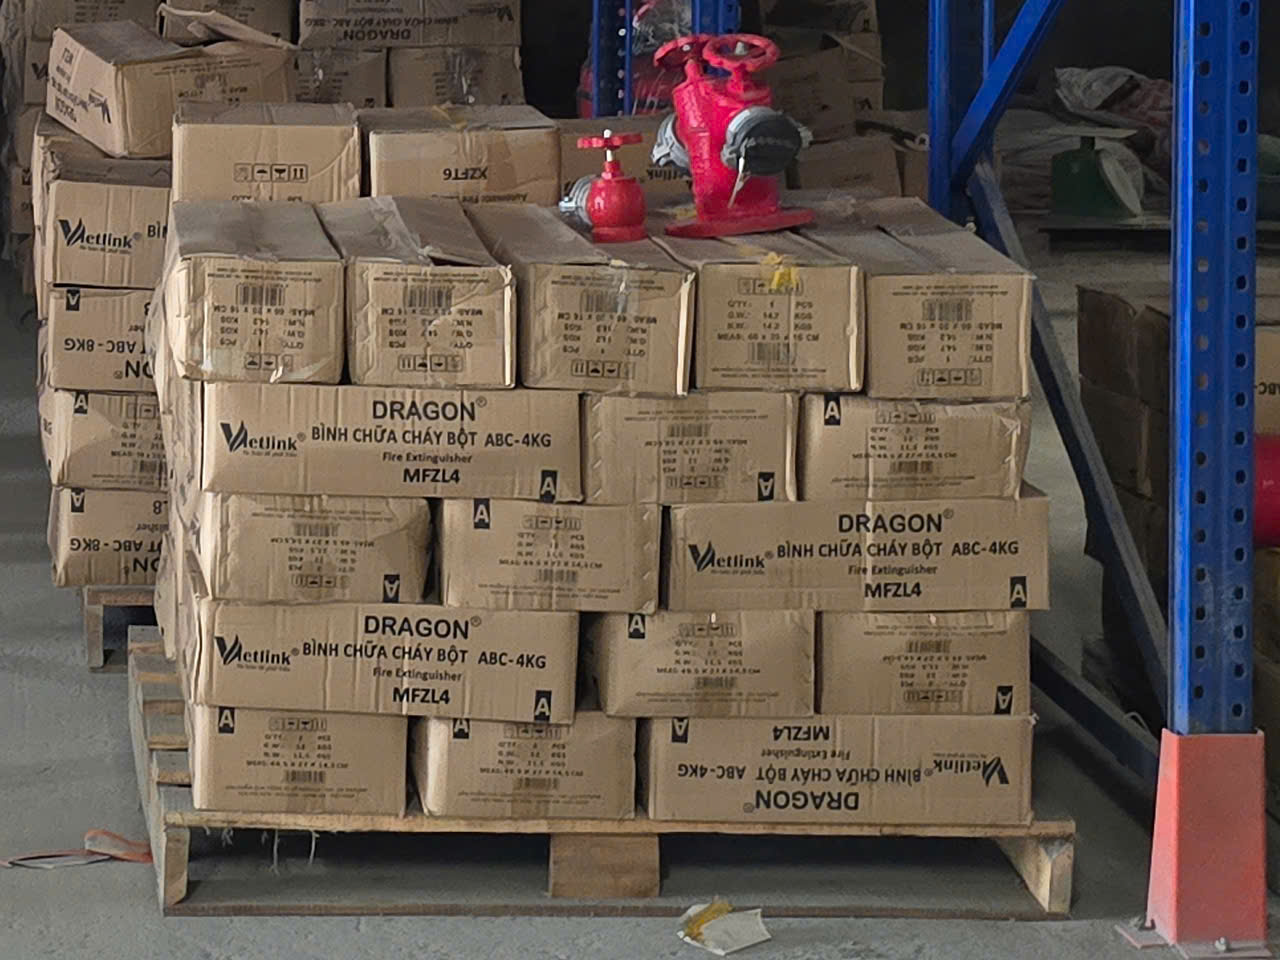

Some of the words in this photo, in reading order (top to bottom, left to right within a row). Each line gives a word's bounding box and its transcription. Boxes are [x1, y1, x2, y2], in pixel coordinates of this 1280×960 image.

[343, 28, 411, 41] DRAGON
[443, 167, 488, 181] XZFT6
[75, 394, 88, 410] A
[372, 400, 476, 422] DRAGON
[825, 401, 839, 420] A
[312, 422, 348, 442] BÌNH
[352, 424, 398, 444] CHỮA
[402, 426, 442, 446] CHÁY
[448, 427, 478, 449] BỘT
[484, 433, 552, 447] ABC-4KG
[383, 451, 403, 462] Fire
[406, 452, 472, 464] Extinguisher
[402, 468, 460, 484] MFZL4
[541, 476, 556, 494] A
[758, 478, 774, 496] A
[72, 492, 85, 506] A
[474, 504, 490, 522] A
[839, 514, 942, 532] DRAGON
[776, 540, 813, 558] BÌNH
[818, 538, 862, 558] CHỮA
[866, 538, 908, 556] CHÁY
[912, 538, 942, 559] BỘT
[952, 540, 1020, 556] ABC-4KG
[848, 564, 868, 575] Fire
[872, 564, 938, 576] Extinguisher
[384, 580, 400, 598] A
[864, 582, 922, 598] MFZL4
[1010, 584, 1026, 601] A
[364, 616, 469, 640] DRAGON
[629, 614, 645, 633] A
[302, 638, 338, 657] BÌNH
[344, 640, 388, 659] CHỮA
[392, 642, 433, 662] CHÁY
[437, 644, 468, 666] BỘT
[478, 651, 546, 668] ABC-4KG
[373, 667, 392, 677] Fire
[396, 668, 463, 682] Extinguisher
[392, 687, 450, 704] MFZL4
[998, 692, 1012, 709] A
[536, 698, 550, 716] A
[218, 709, 234, 728] A
[672, 718, 688, 735] A
[772, 726, 830, 742] MFZL4
[761, 748, 827, 760] Extinguisher
[830, 750, 850, 760] Fire
[677, 764, 746, 780] ABC-4KG
[756, 764, 786, 784] BỘT
[791, 768, 832, 786] CHÁY
[836, 768, 880, 786] CHỮA
[884, 768, 922, 788] BÌNH
[755, 790, 860, 810] DRAGON
